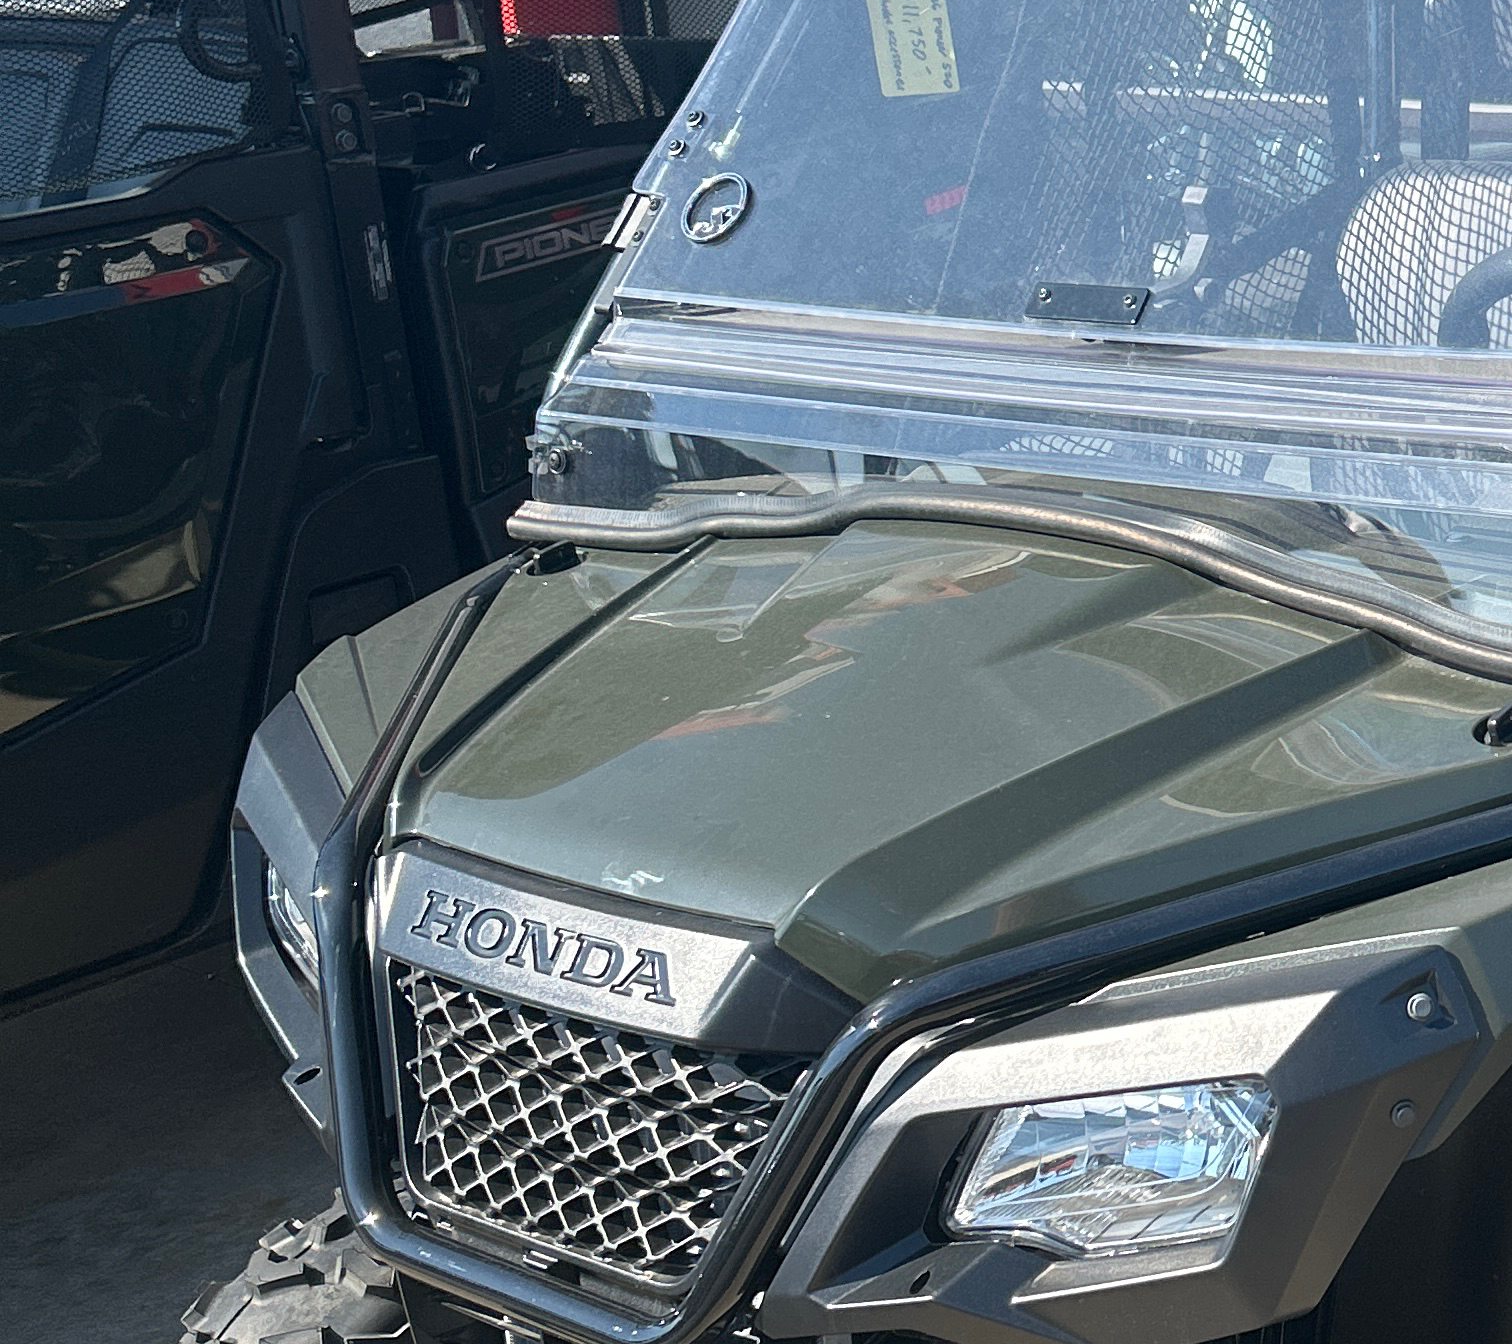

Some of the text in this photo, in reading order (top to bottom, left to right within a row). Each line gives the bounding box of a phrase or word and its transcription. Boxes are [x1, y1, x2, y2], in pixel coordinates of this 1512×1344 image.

[942, 63, 953, 89] 520
[494, 216, 612, 268] PIONE
[410, 889, 677, 1007] HONDA
